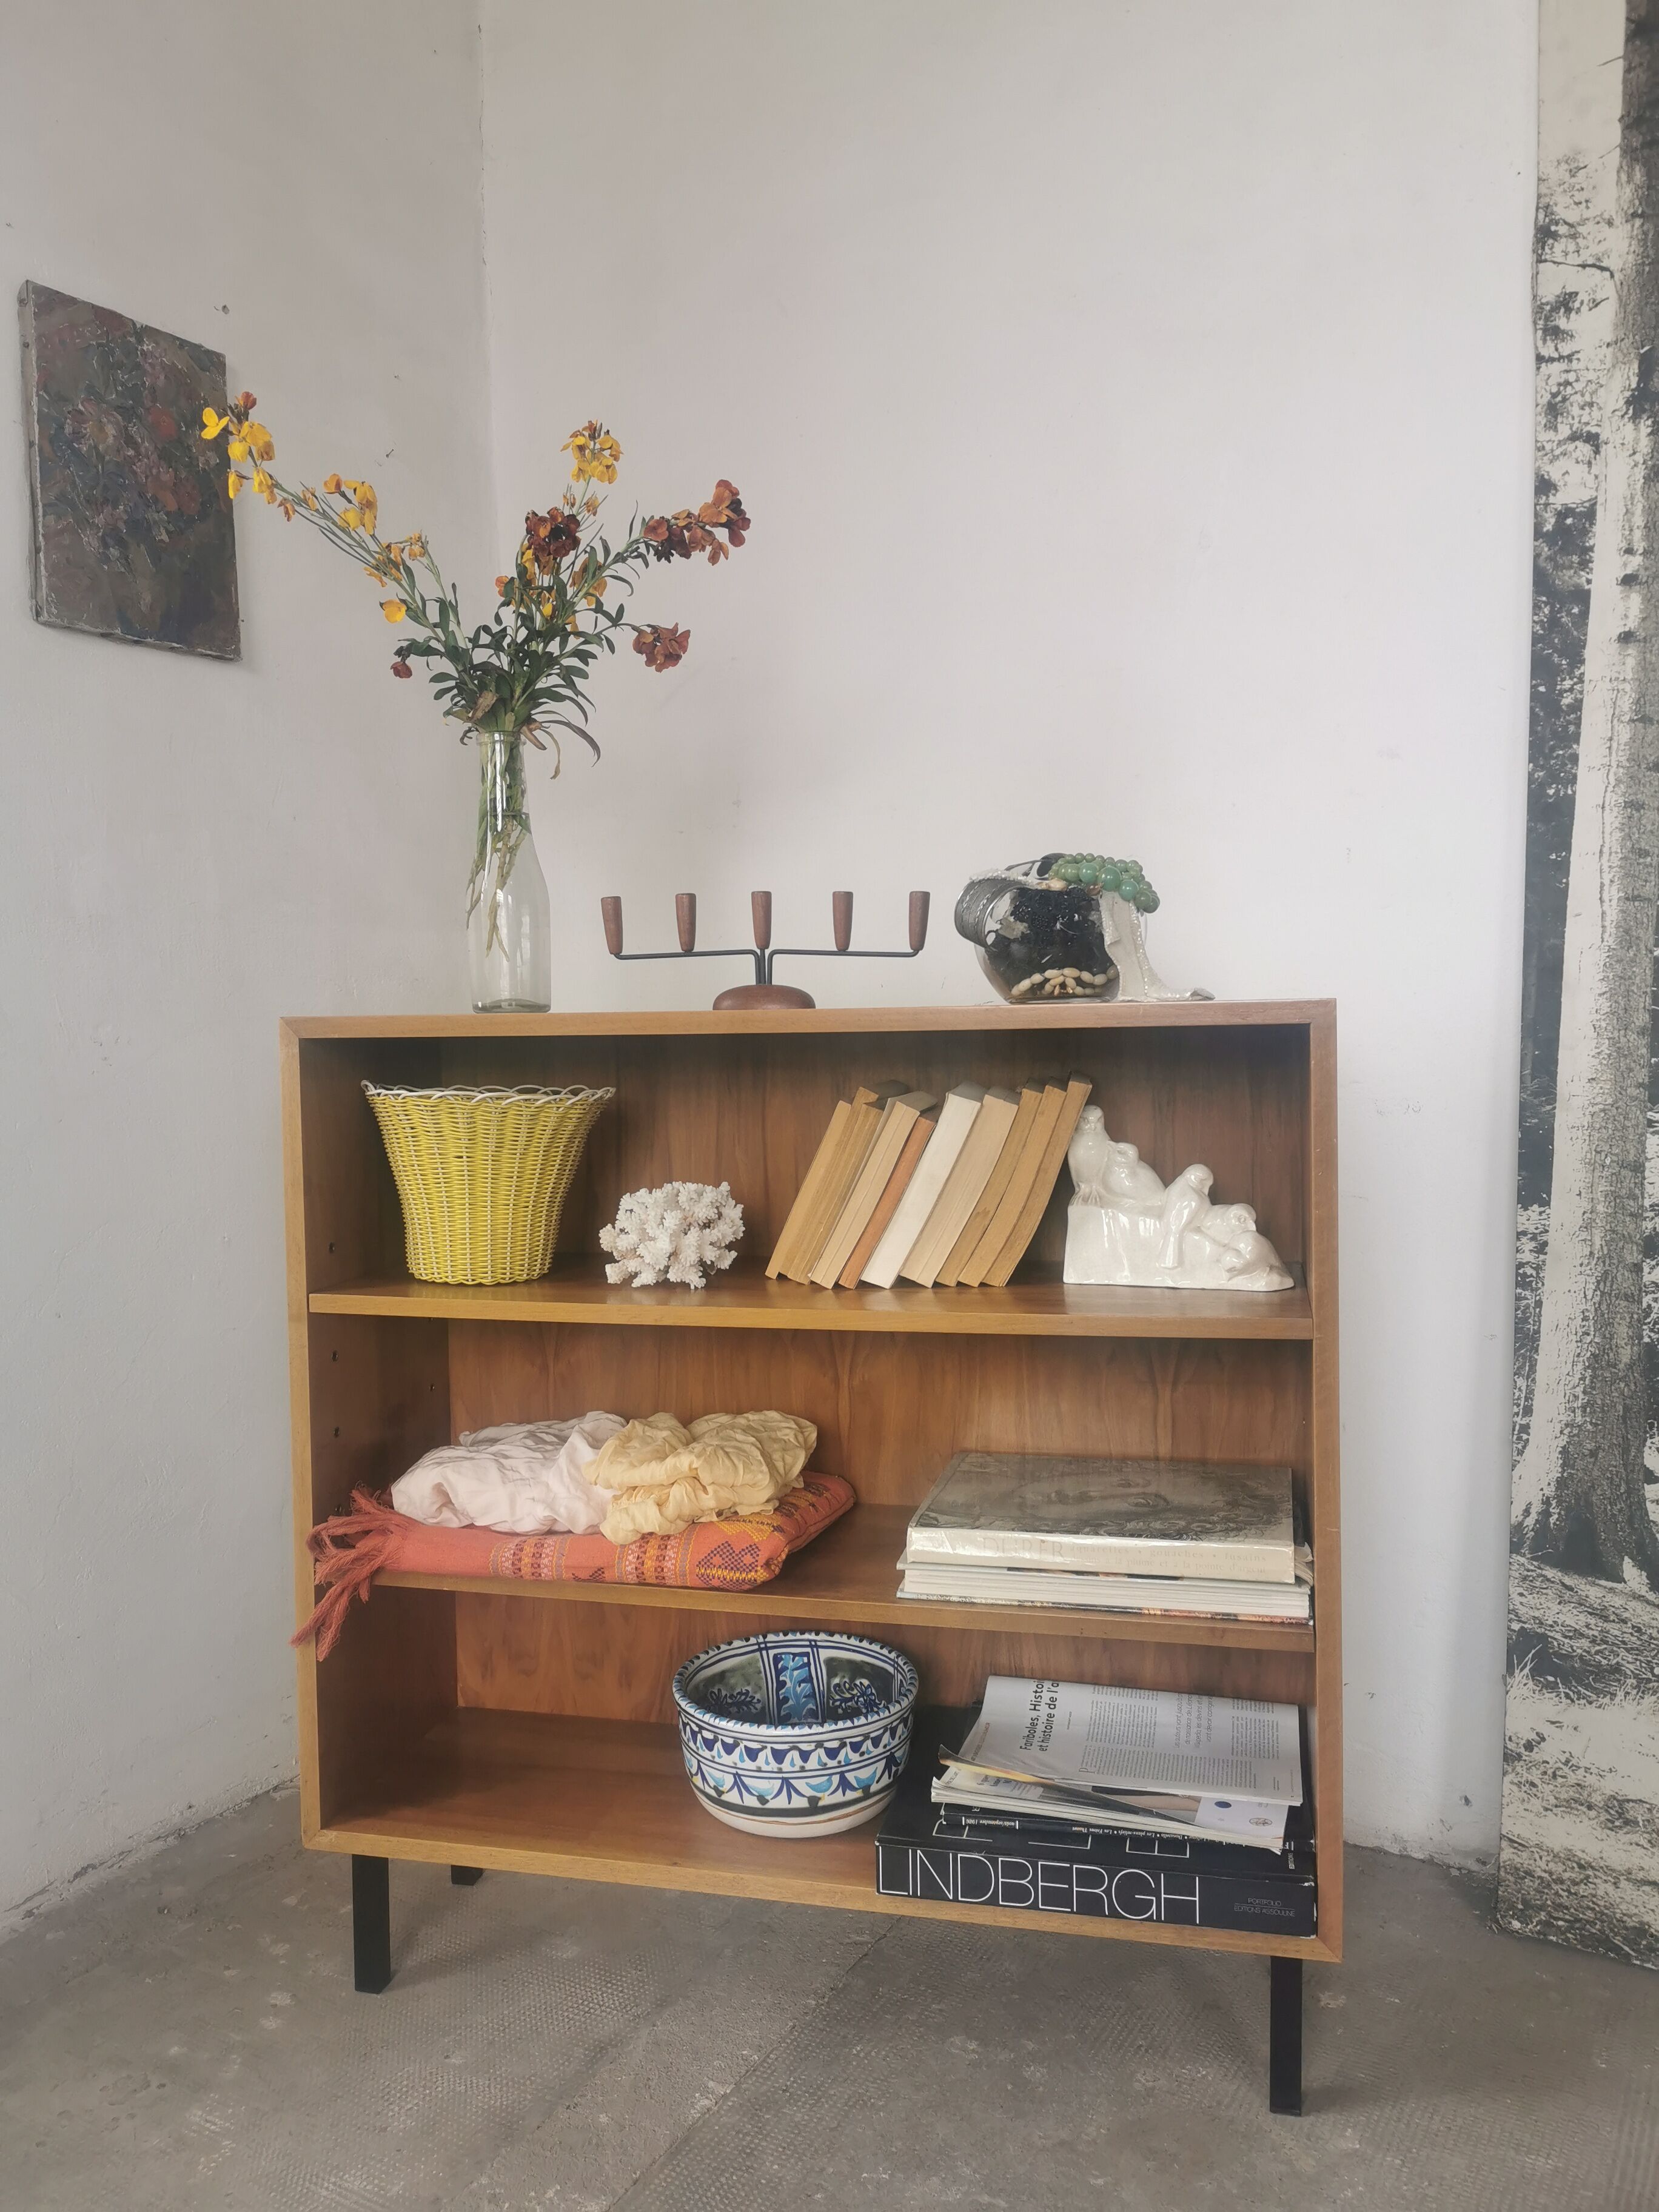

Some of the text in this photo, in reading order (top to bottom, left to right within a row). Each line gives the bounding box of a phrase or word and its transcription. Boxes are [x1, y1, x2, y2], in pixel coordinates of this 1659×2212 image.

[1150, 1549, 1204, 1559] gouaches
[1225, 1552, 1267, 1562] fusains
[1127, 1557, 1154, 1568] plume
[1183, 1561, 1191, 1569] la
[1195, 1562, 1224, 1572] pointe
[1046, 1682, 1060, 1694] l'a
[1045, 1696, 1057, 1710] de
[1019, 1680, 1045, 1751] Fariboles, Histoi
[1037, 1712, 1055, 1744] histoire
[879, 1846, 1199, 1924] LINDBERGH
[1247, 1898, 1282, 1907] PORTFOLIO
[1234, 1905, 1295, 1917] EDITIONS ASSOULINE
